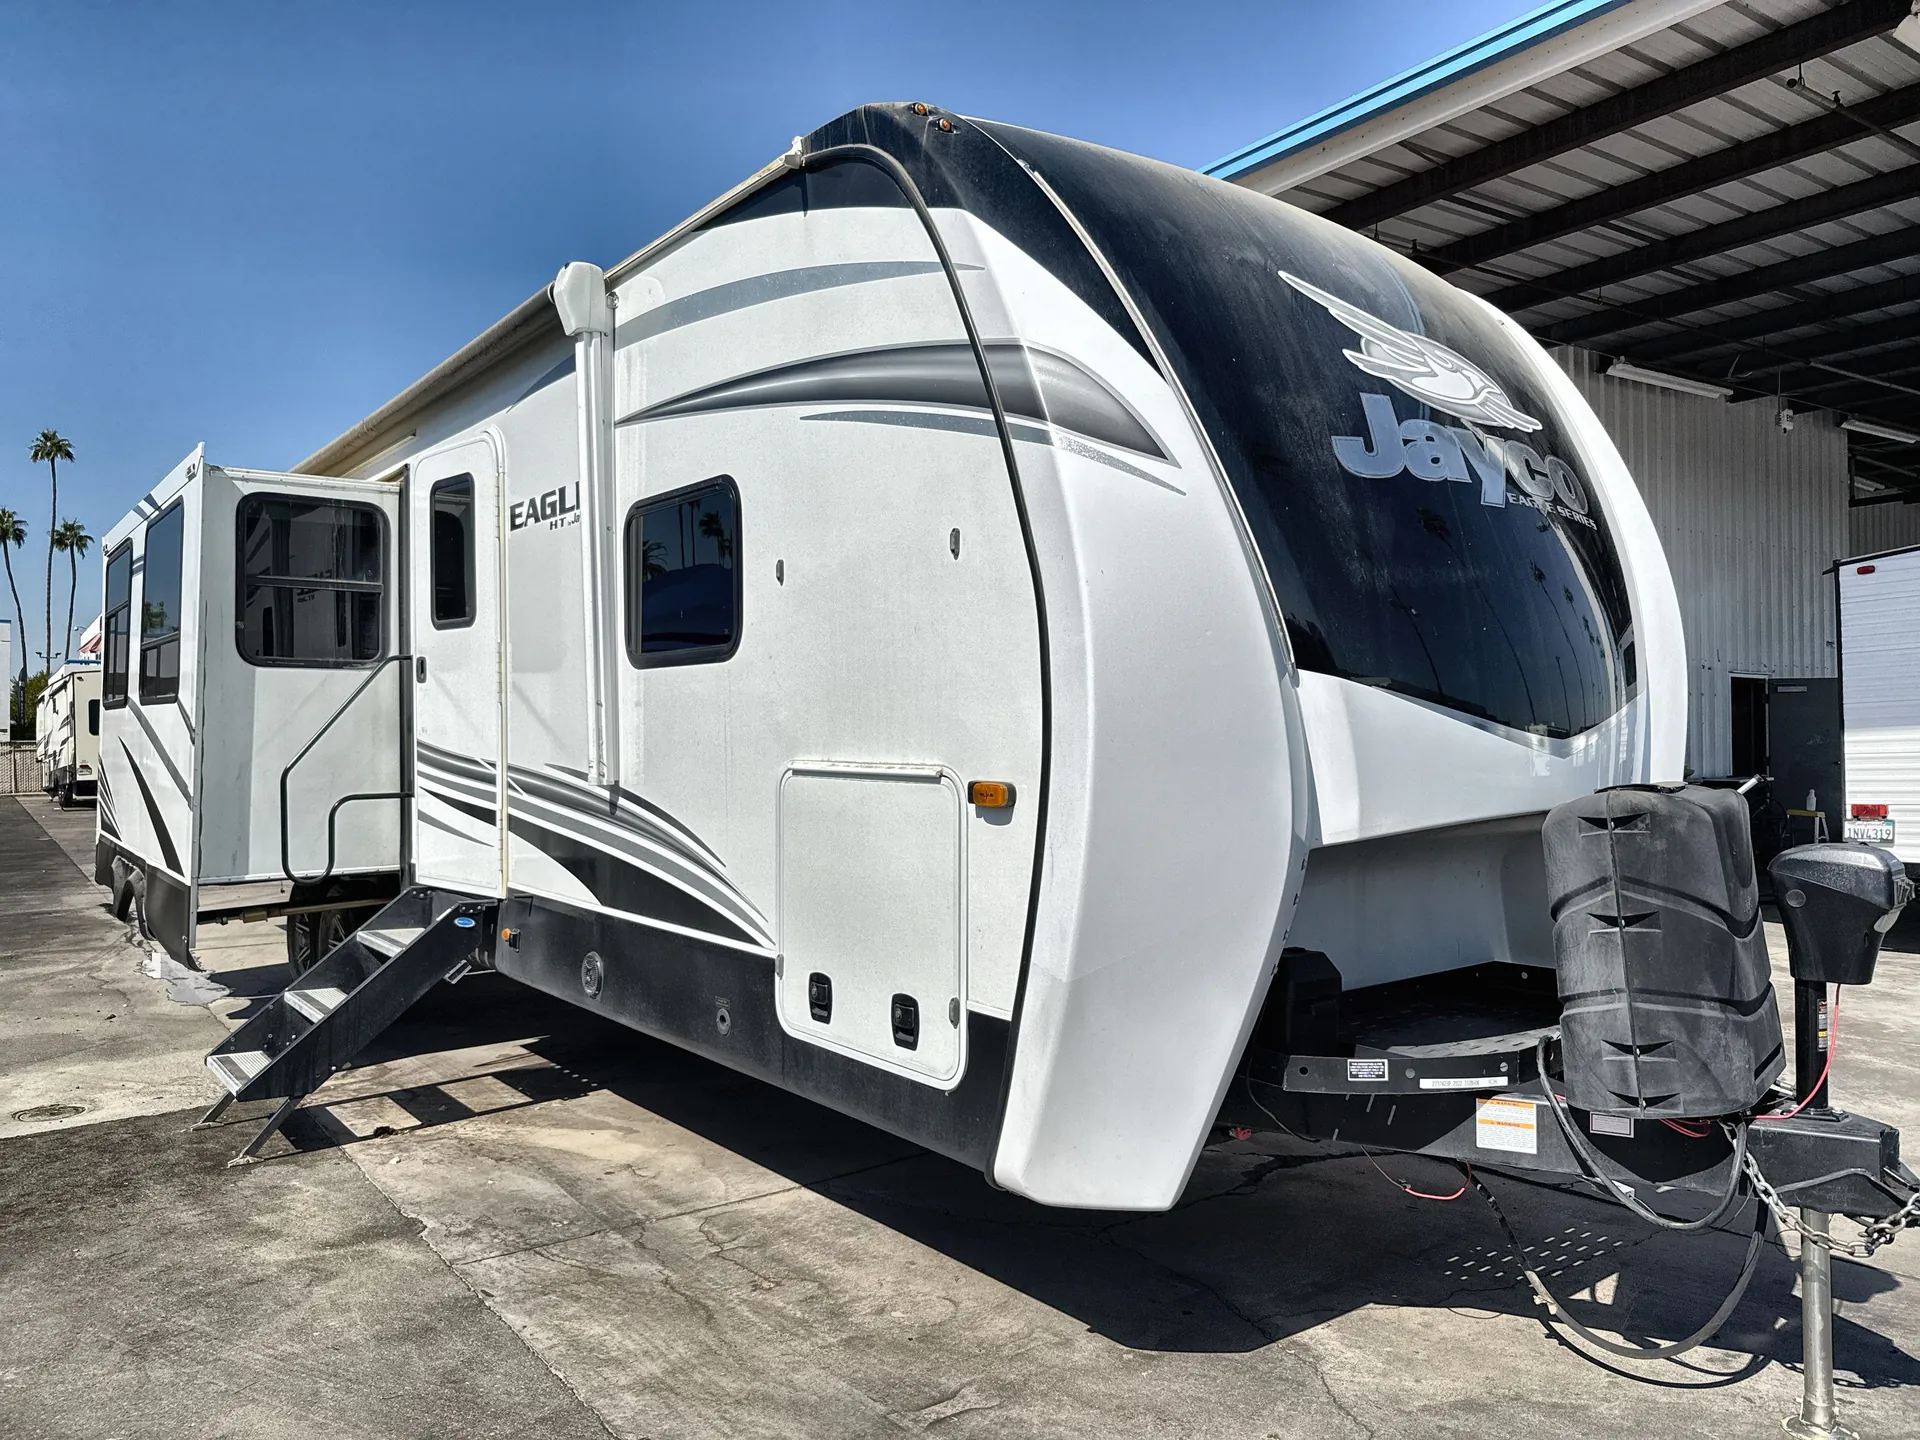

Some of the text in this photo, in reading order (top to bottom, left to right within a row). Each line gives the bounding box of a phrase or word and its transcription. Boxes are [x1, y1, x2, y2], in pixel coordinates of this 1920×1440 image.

[1331, 392, 1588, 514] Jayco
[549, 517, 566, 530] HT
[1557, 505, 1598, 531] SERIES
[1848, 828, 1891, 840] 1NV4319
